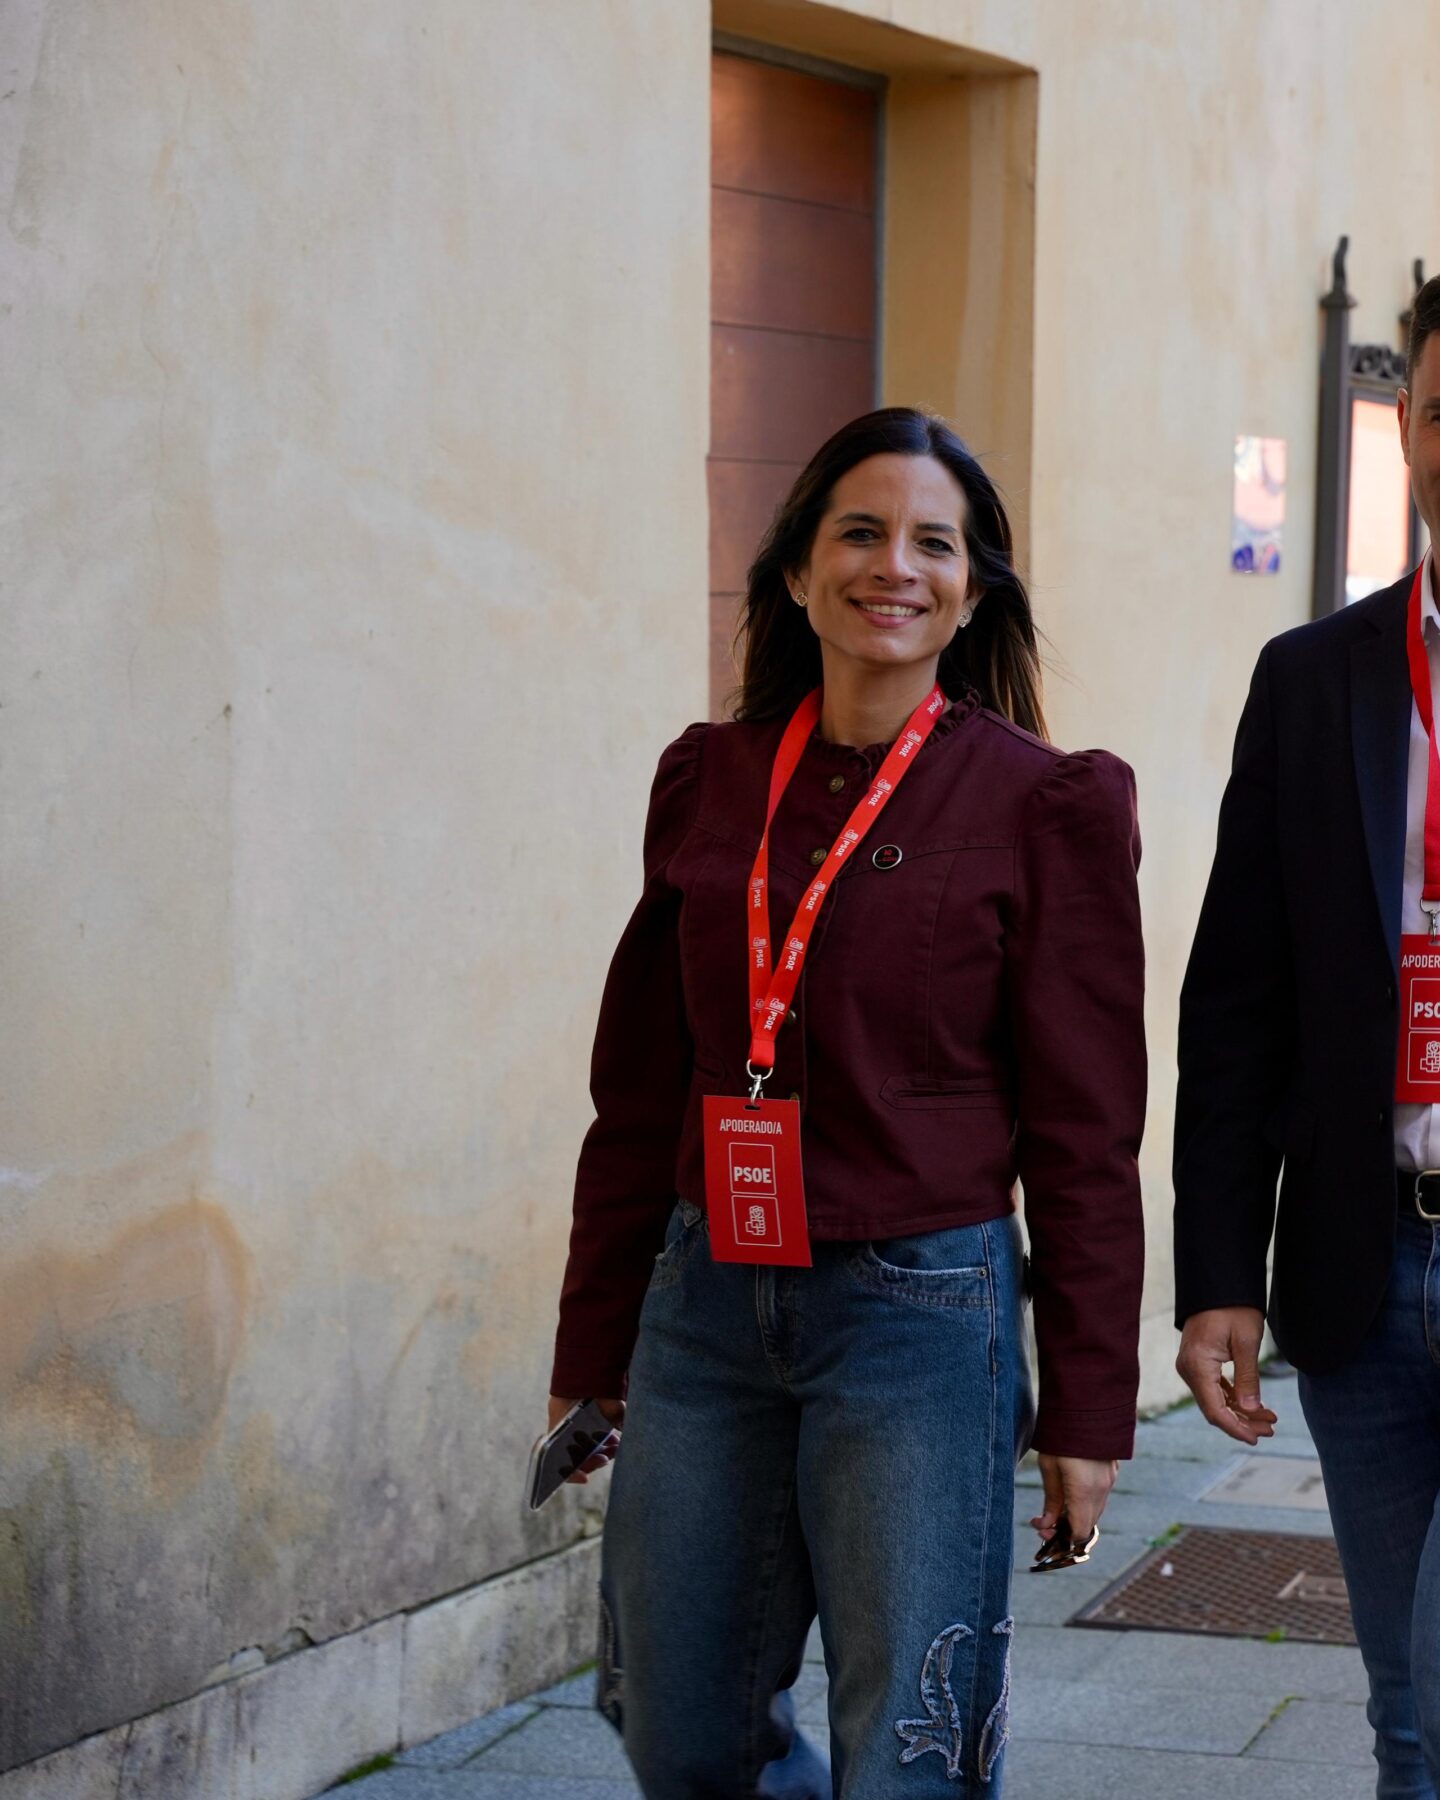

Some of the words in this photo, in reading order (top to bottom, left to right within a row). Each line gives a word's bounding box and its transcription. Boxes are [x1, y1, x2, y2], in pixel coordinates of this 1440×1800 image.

[899, 740, 914, 757] PSOE
[868, 790, 883, 805] PSOE
[836, 840, 850, 856] PSOE
[806, 892, 819, 910] PSOE
[756, 949, 764, 969] PSOE
[786, 951, 797, 970] PSOE
[764, 1011, 778, 1030] PSOE
[719, 1118, 783, 1135] APODERADO/A
[733, 1166, 773, 1184] PSOE
